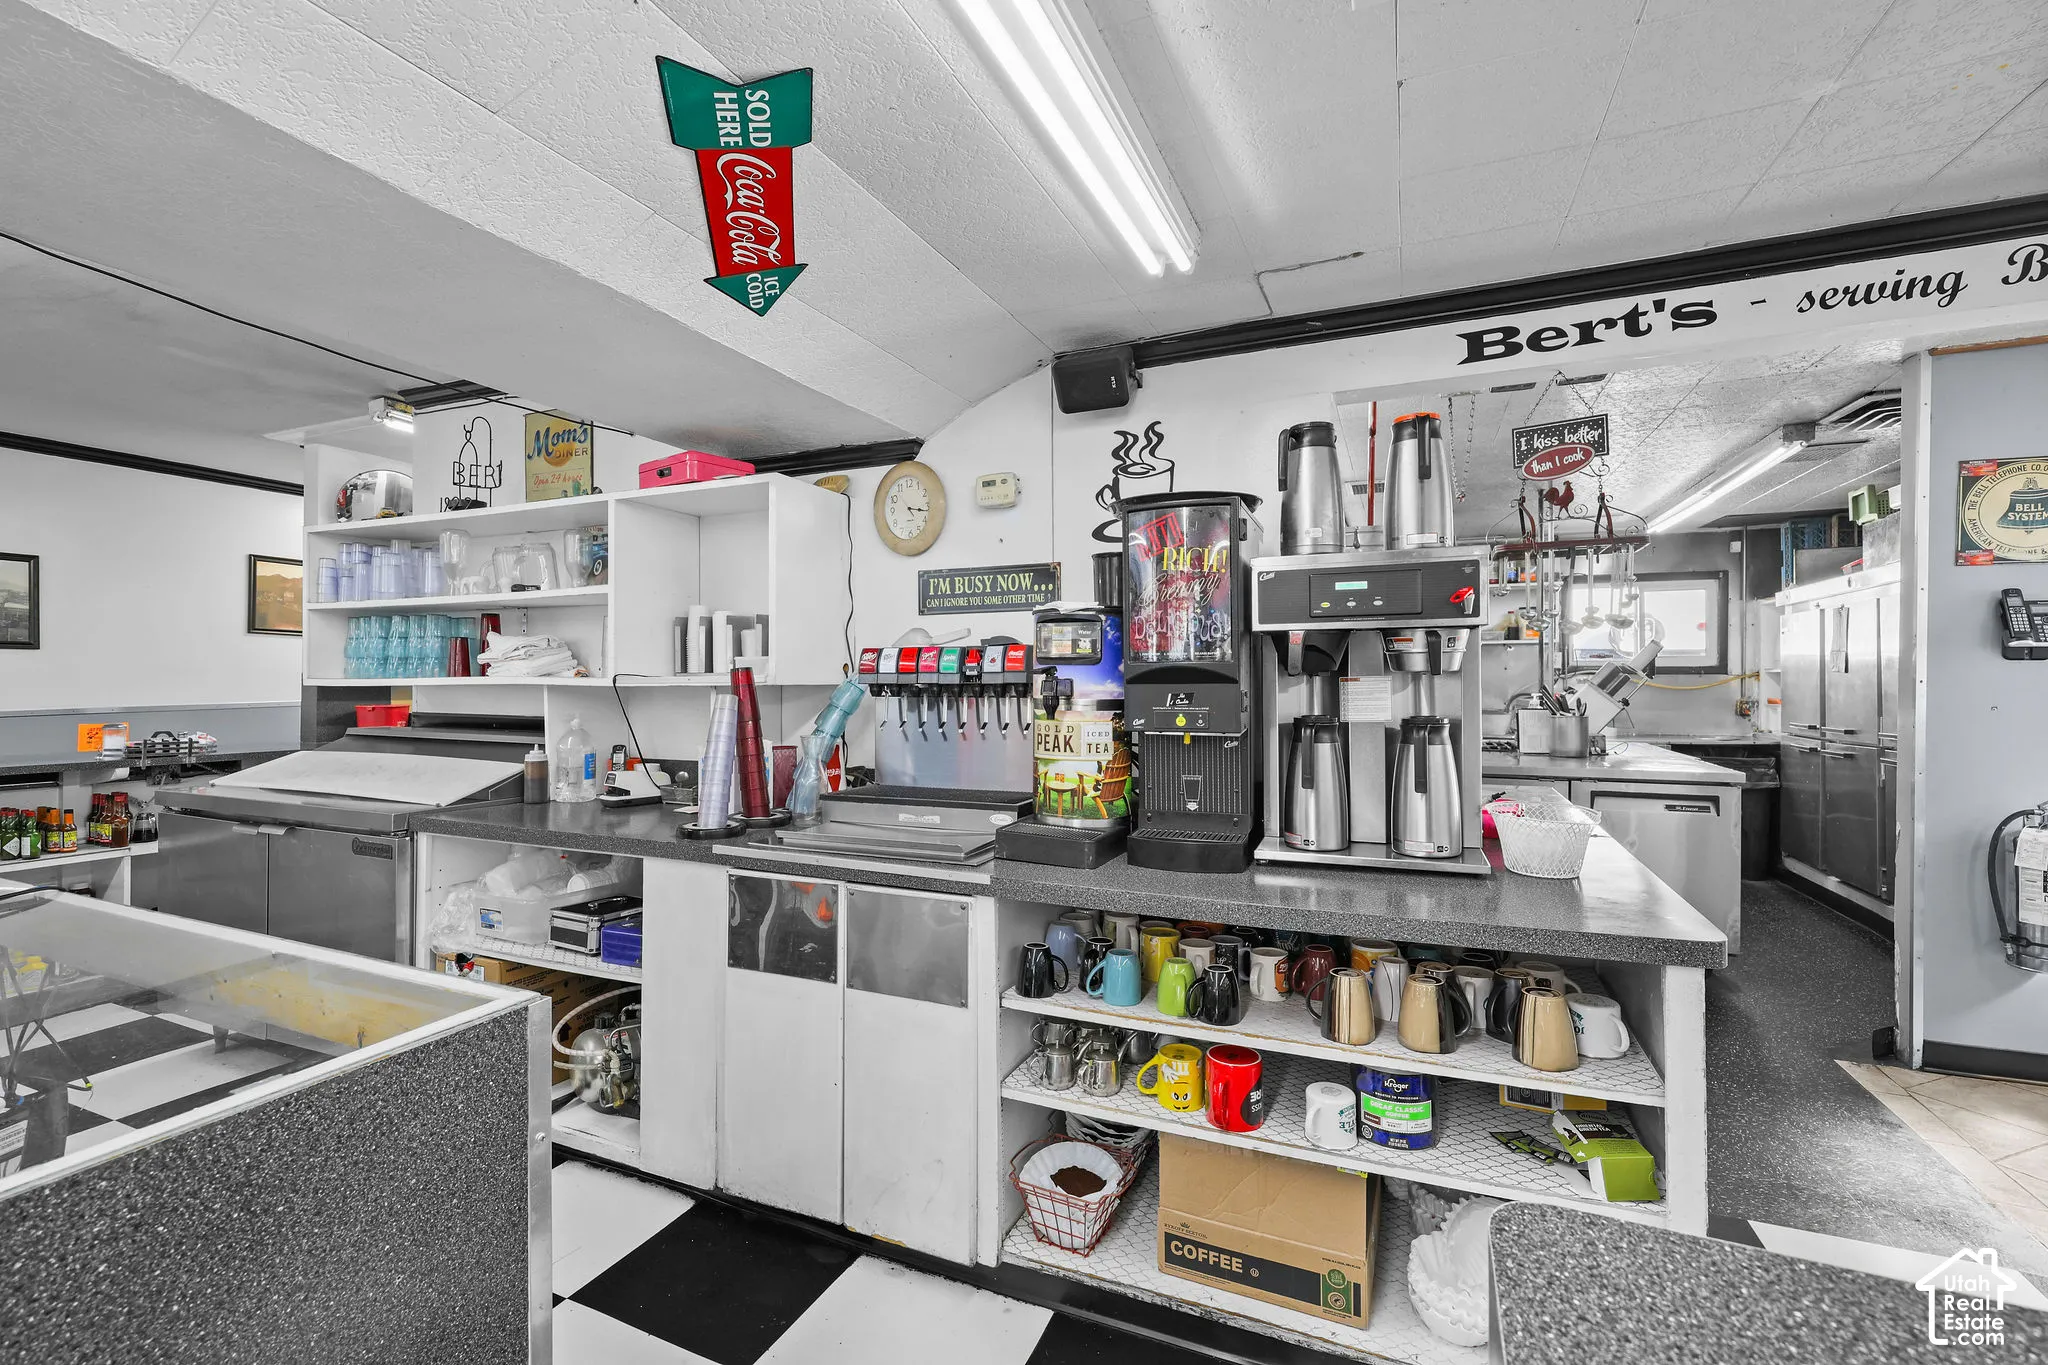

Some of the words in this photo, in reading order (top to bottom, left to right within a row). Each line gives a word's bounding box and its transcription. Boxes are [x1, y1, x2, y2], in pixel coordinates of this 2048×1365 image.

[713, 91, 743, 147] HERE
[745, 89, 772, 148] SOLD
[746, 272, 764, 309] COLD
[763, 276, 780, 297] ICE
[1456, 297, 1718, 366] Bert's
[1796, 267, 1968, 313] serving
[527, 421, 589, 461] Mom's
[1520, 437, 1527, 450] I
[1533, 434, 1560, 449] kiss
[1564, 425, 1602, 444] better
[555, 447, 589, 459] DINER
[1531, 459, 1553, 474] than
[1555, 456, 1560, 466] I
[1563, 448, 1585, 465] cook
[1967, 499, 1979, 511] THE
[1975, 483, 1989, 499] BELL
[1986, 464, 2028, 485] TELEPHONE
[2015, 503, 2045, 512] BELL
[1967, 518, 1994, 548] AMERICAN
[1162, 547, 1227, 573] RICH!
[929, 577, 952, 596] I'M
[954, 575, 994, 594] BUSY
[996, 572, 1053, 592] NOW...
[926, 598, 939, 608] CAN
[943, 597, 968, 607] IGNORE
[969, 596, 983, 606] YOU
[984, 596, 1001, 605] SOME
[1003, 594, 1026, 604] OTHER
[1027, 593, 1045, 603] TIME
[1037, 723, 1075, 733] GOLD
[1037, 732, 1075, 753] PEAK
[1087, 743, 1109, 754] TEA
[1384, 1078, 1409, 1093] Kroger
[1170, 1240, 1243, 1273] COFFEE
